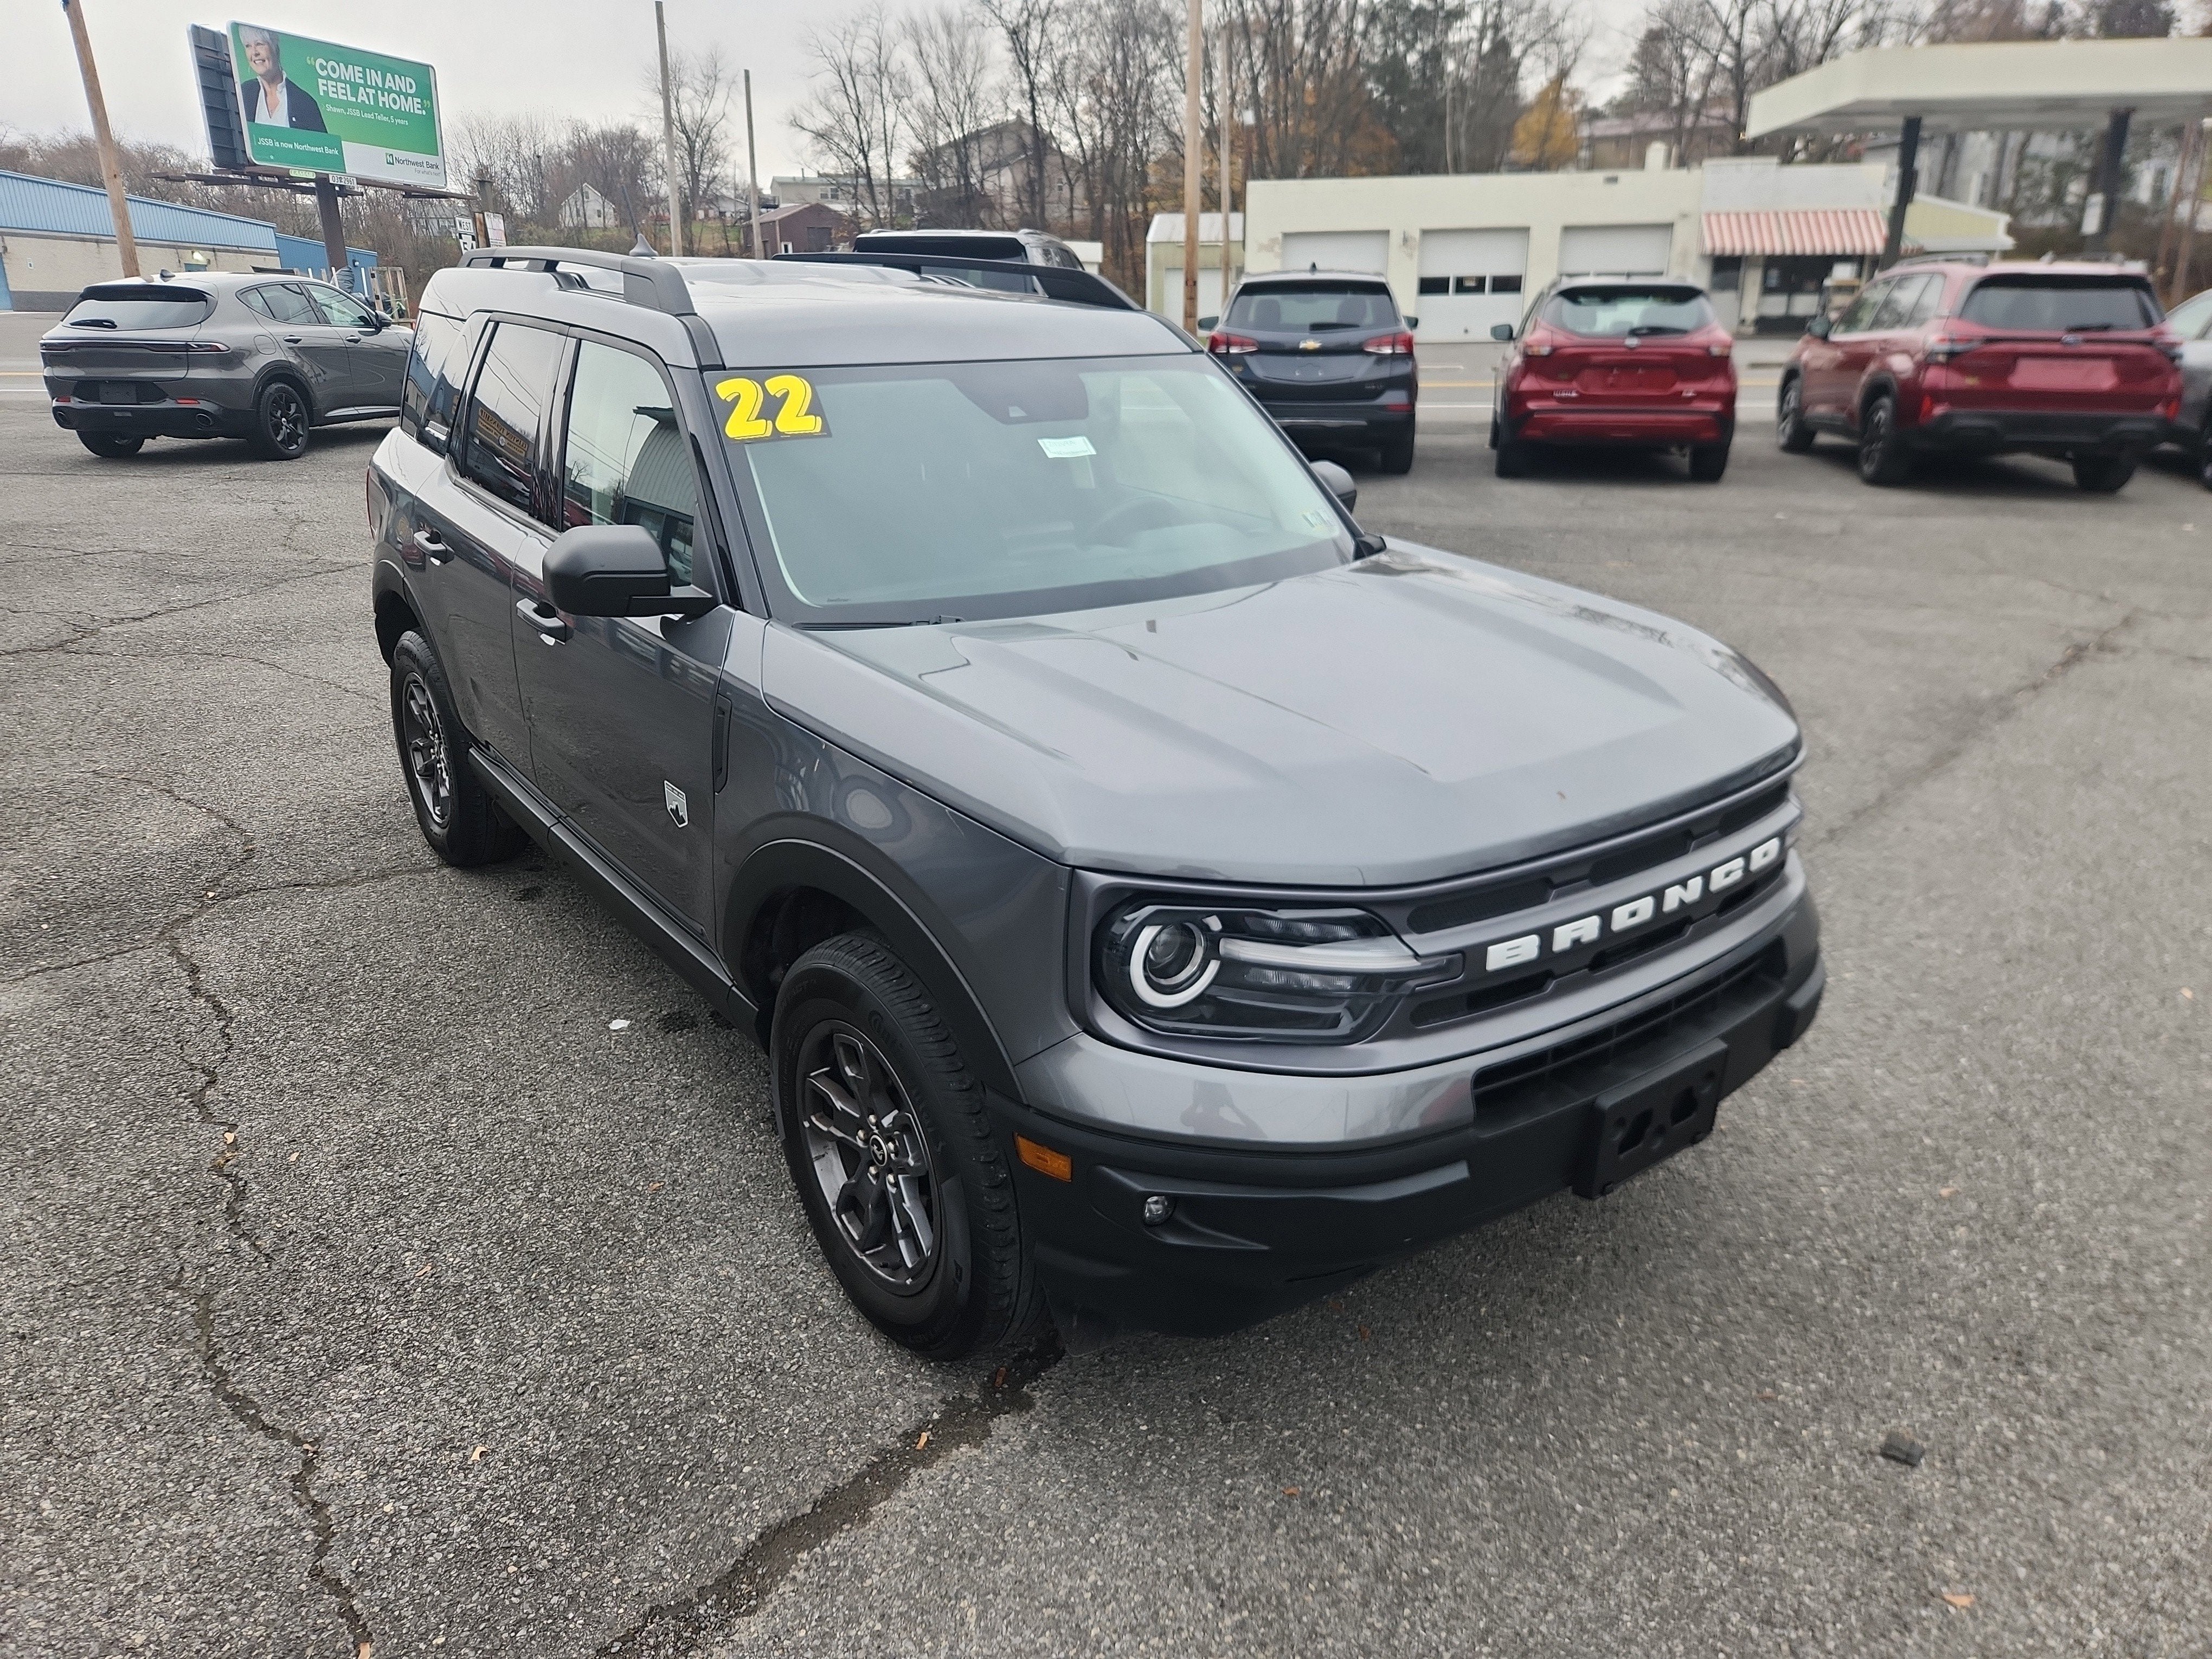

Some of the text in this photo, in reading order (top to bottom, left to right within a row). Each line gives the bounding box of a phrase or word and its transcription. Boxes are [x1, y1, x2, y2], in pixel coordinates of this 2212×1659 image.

[318, 78, 356, 102] FEEL
[357, 86, 375, 105] AT
[365, 68, 382, 87] IN
[384, 73, 416, 94] AND
[326, 104, 346, 114] Shawn,
[346, 107, 360, 117] JSSB
[361, 110, 374, 119] Lead
[375, 113, 390, 123] Teller,
[258, 137, 273, 146] JSSB
[294, 142, 324, 153] Northwest
[324, 146, 339, 155] Bank
[395, 156, 440, 170] Northwest Bank
[458, 219, 471, 231] WEST
[716, 374, 822, 439] 22
[1486, 837, 1782, 972] BRONCO
